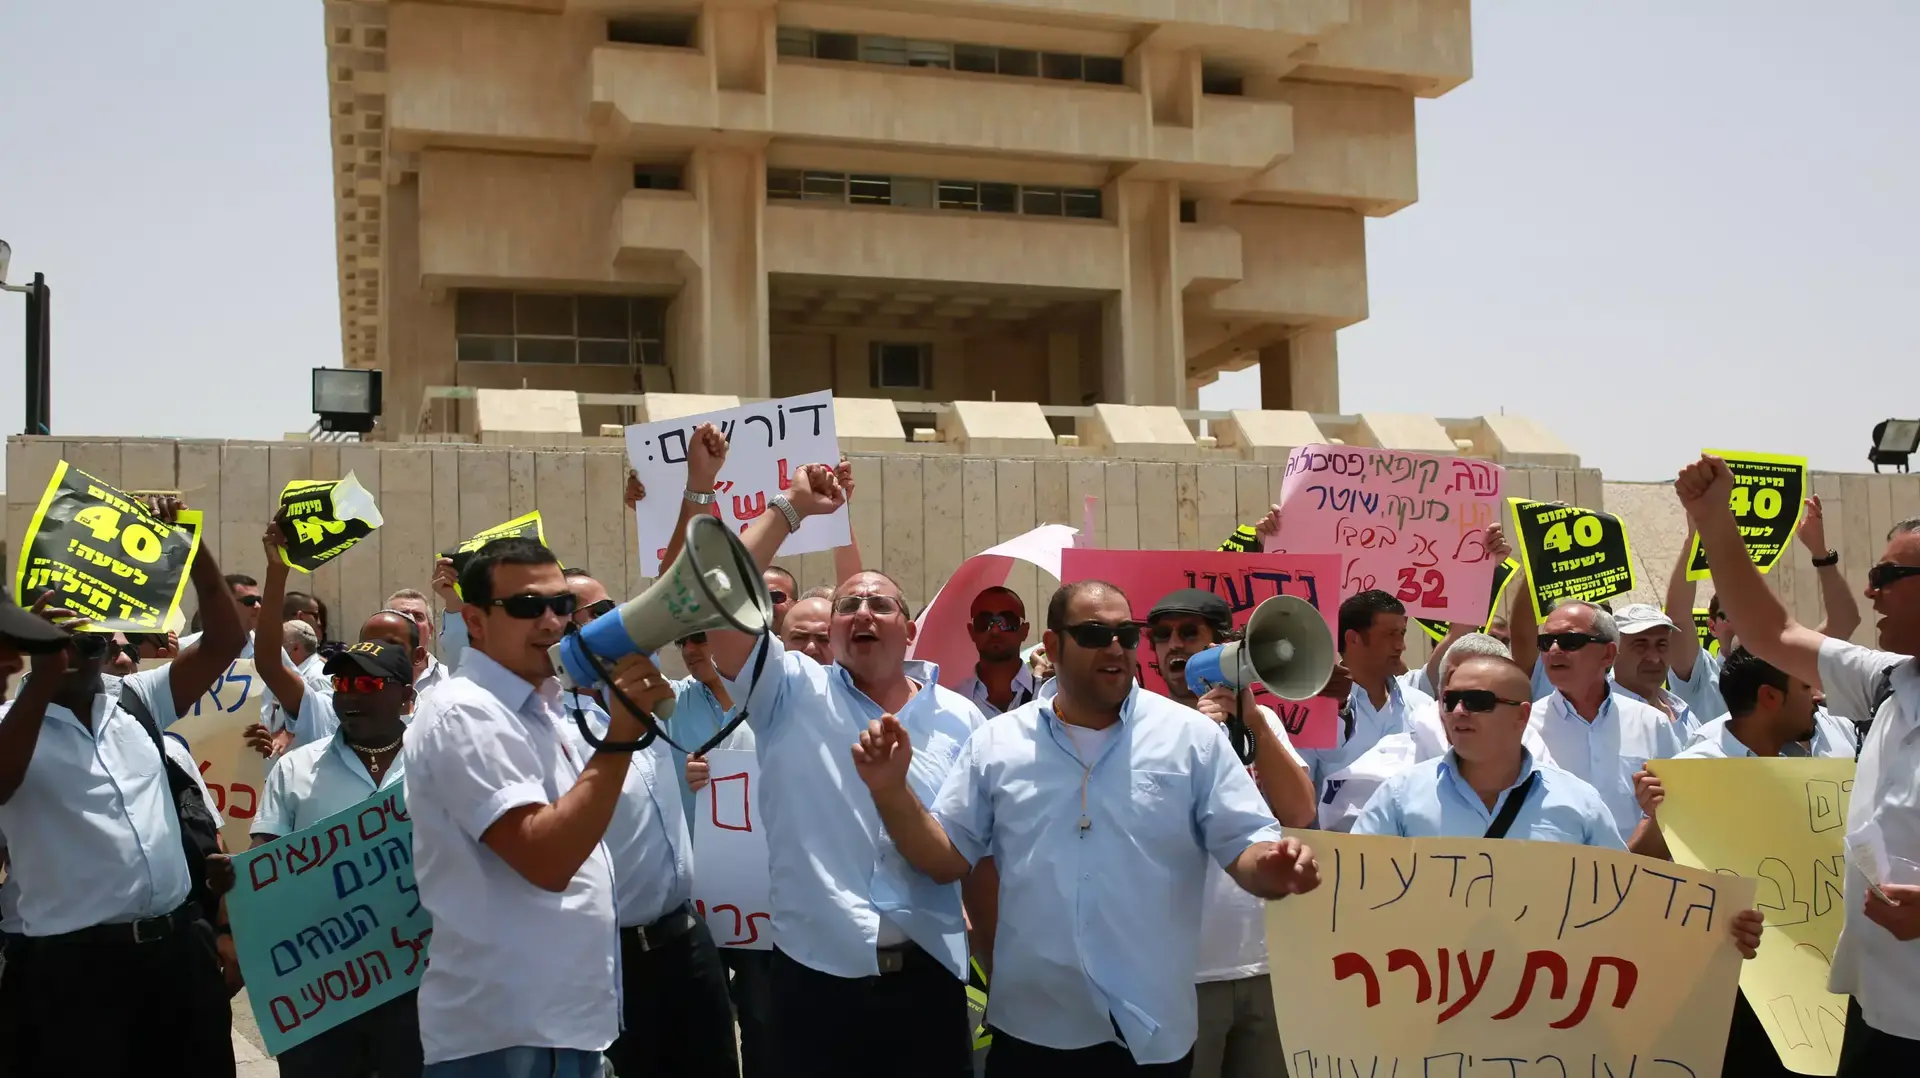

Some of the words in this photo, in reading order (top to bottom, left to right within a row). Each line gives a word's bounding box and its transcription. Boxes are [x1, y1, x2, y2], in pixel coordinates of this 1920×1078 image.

[1306, 486, 1379, 514] שוטר
[1729, 487, 1782, 519] 40
[73, 505, 162, 563] 40
[1543, 515, 1603, 553] 40
[33, 557, 51, 566] יום
[67, 538, 149, 586] לשעה!
[1551, 552, 1605, 573] לשעה!
[27, 568, 113, 612] מיליון
[1396, 567, 1448, 608] 32
[1538, 588, 1563, 602] שלך
[64, 597, 108, 623] אנשים
[119, 603, 159, 628] 1.2
[148, 606, 161, 616] כי
[346, 641, 384, 658] FBI
[1331, 848, 1495, 933] גדעון
